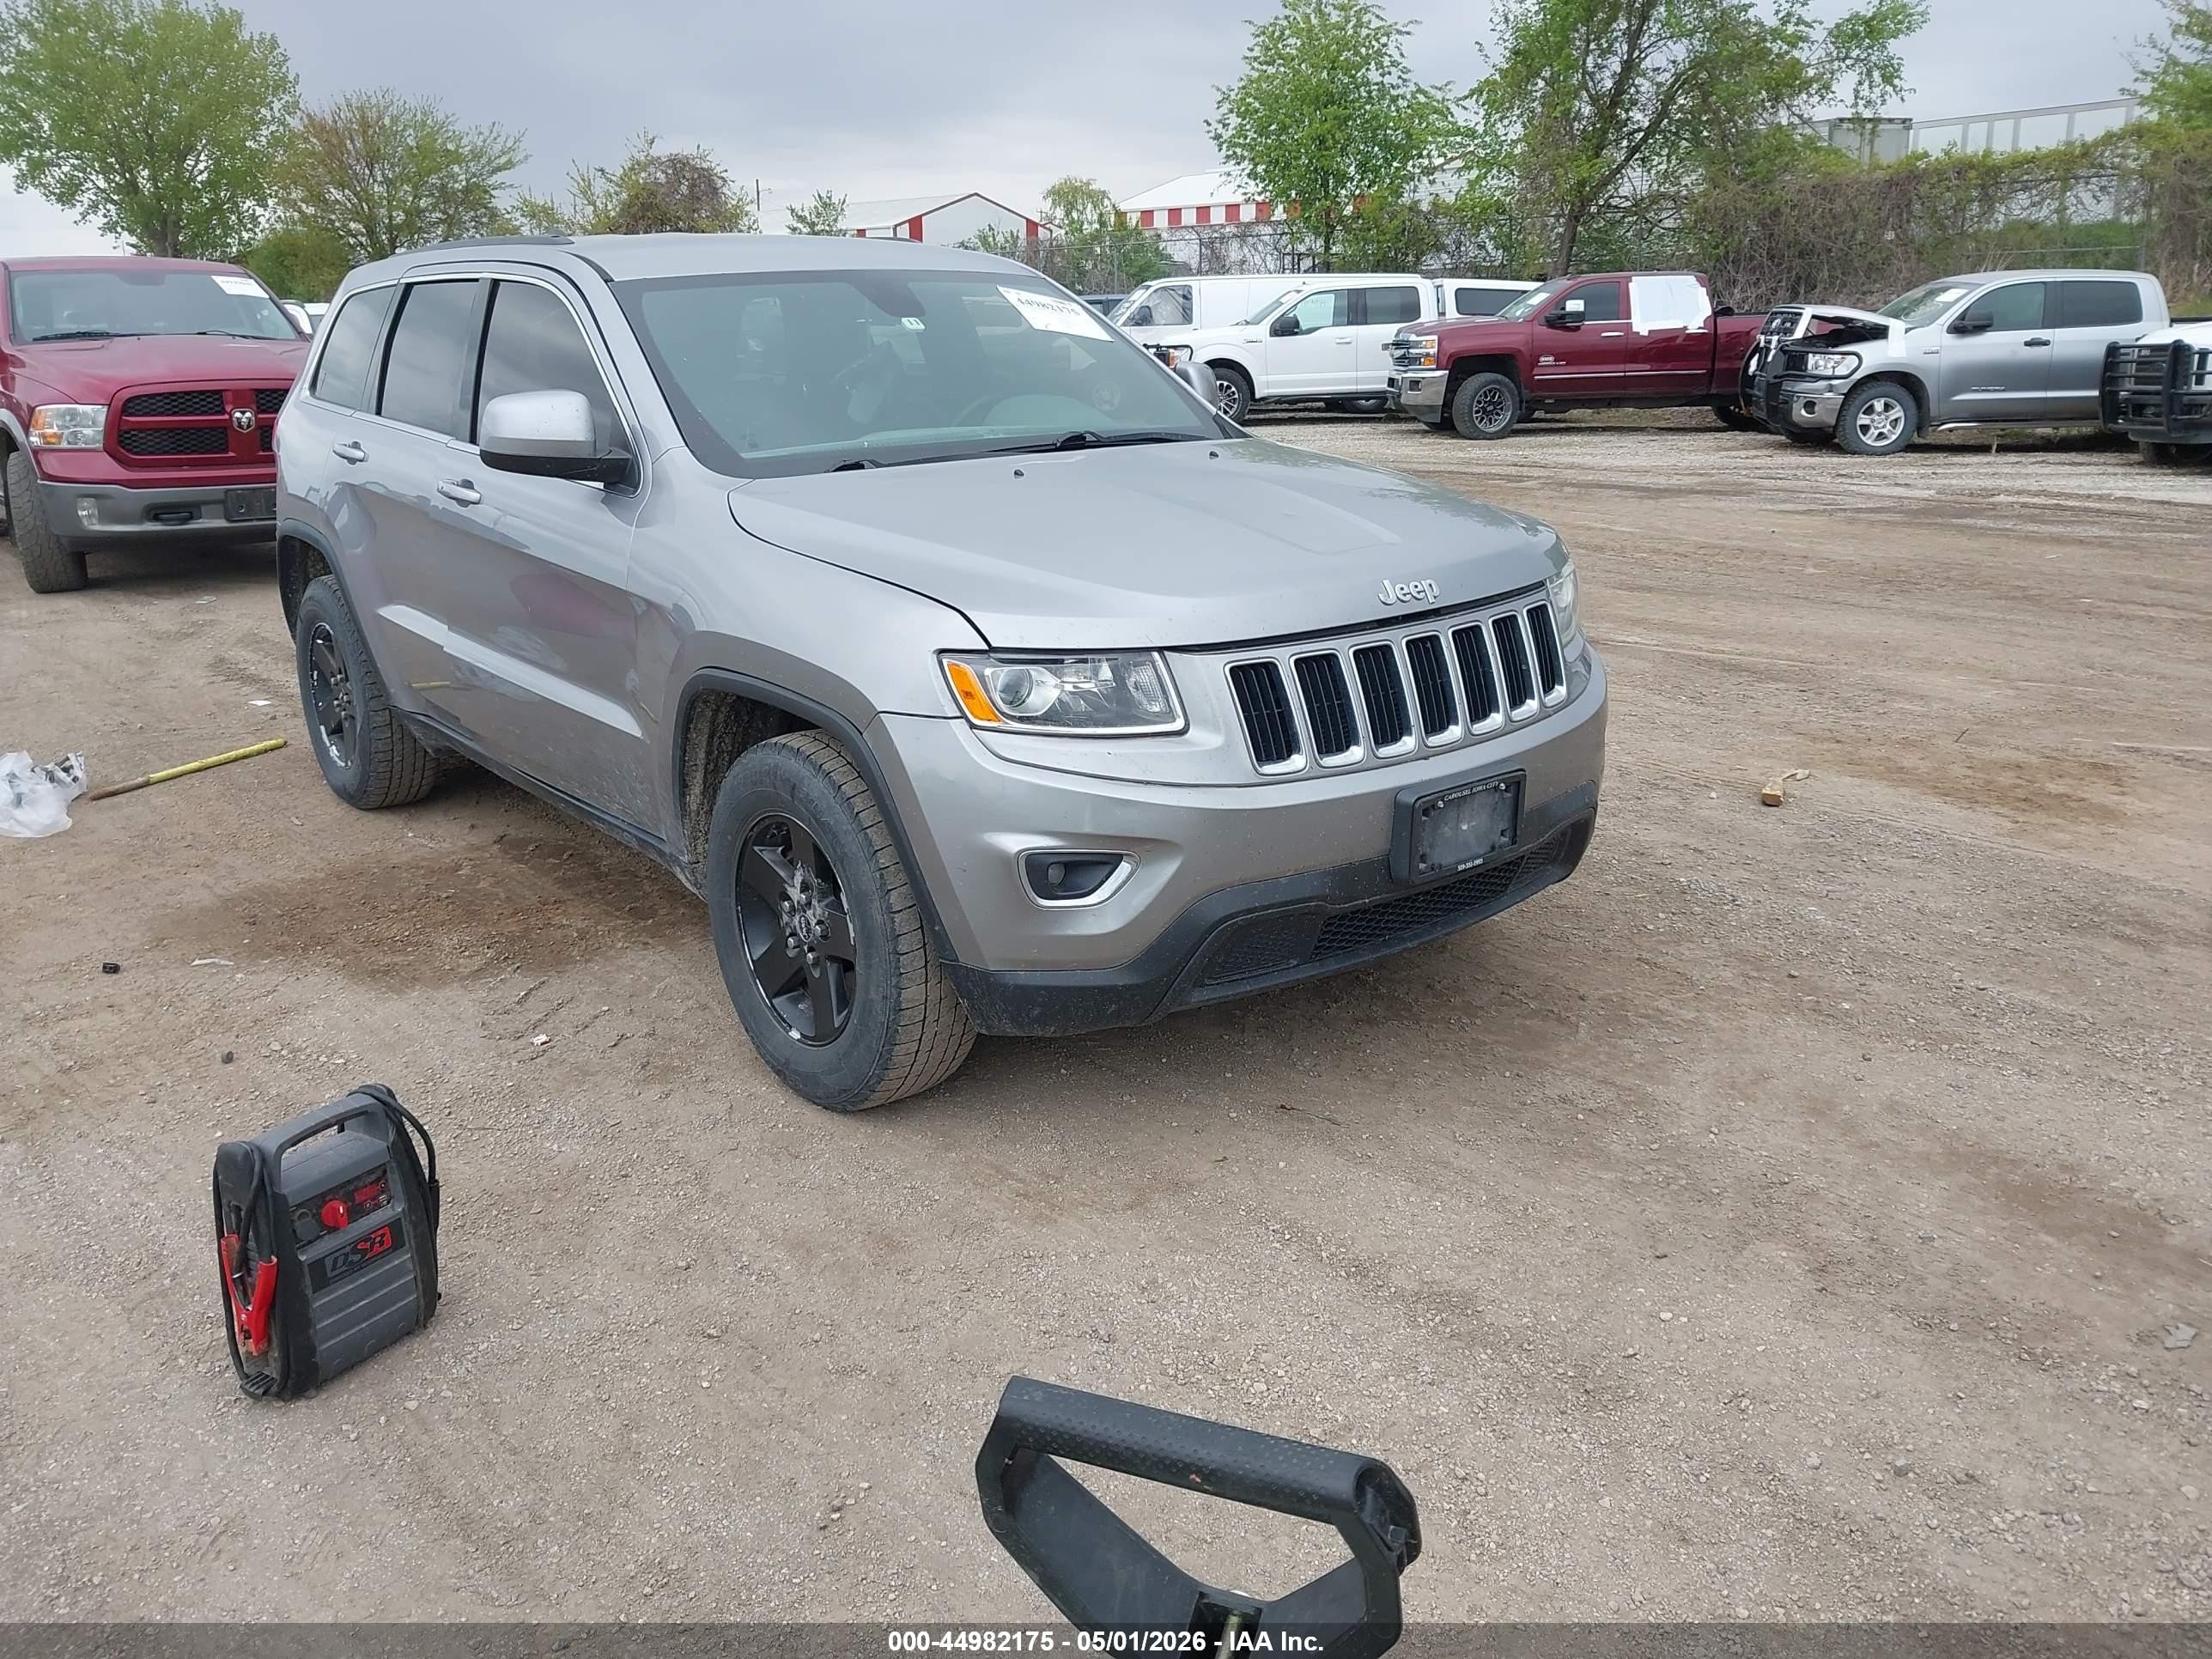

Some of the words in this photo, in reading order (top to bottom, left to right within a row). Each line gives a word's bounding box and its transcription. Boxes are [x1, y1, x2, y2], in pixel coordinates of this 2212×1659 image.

[1377, 578, 1440, 605] Jeep
[1444, 787, 1472, 801] CAROUSEL
[1486, 780, 1498, 789] CITY
